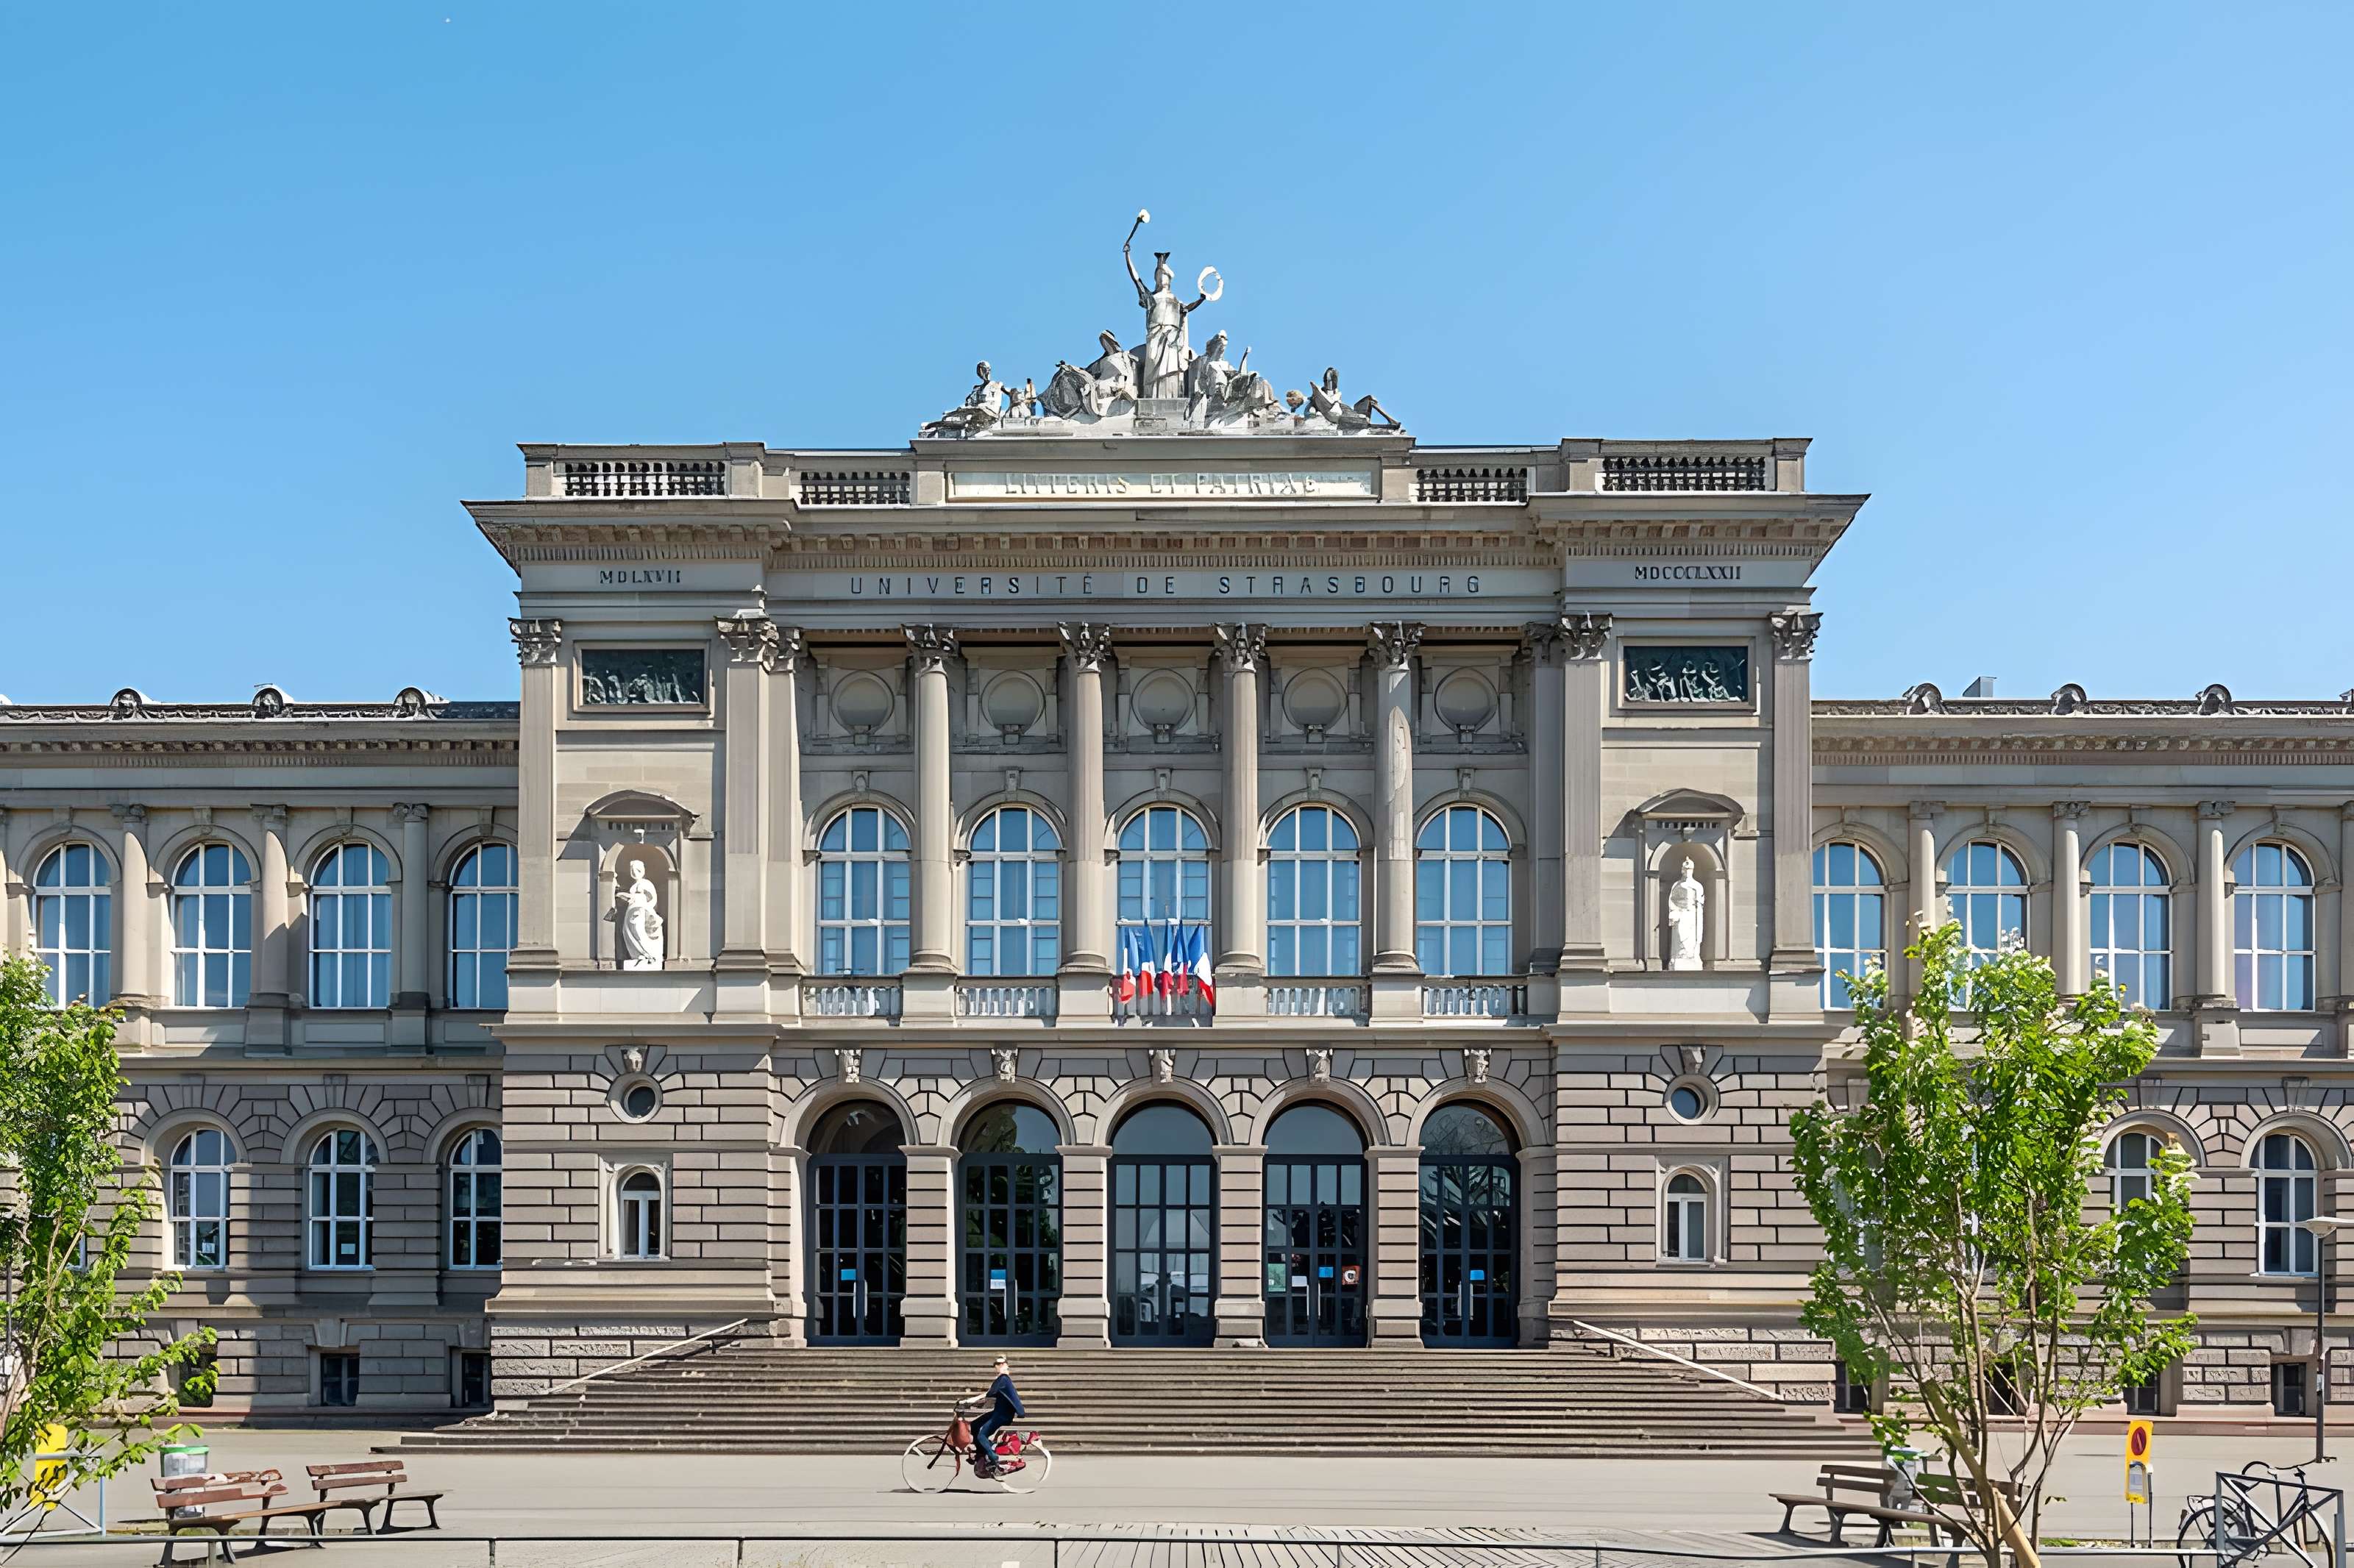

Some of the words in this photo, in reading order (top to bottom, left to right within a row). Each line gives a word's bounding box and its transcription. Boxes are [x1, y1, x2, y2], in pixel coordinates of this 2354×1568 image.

[850, 571, 1092, 594] UNIVERSITÉ
[1137, 576, 1175, 594] DE
[1218, 576, 1479, 594] STRASBOURG
